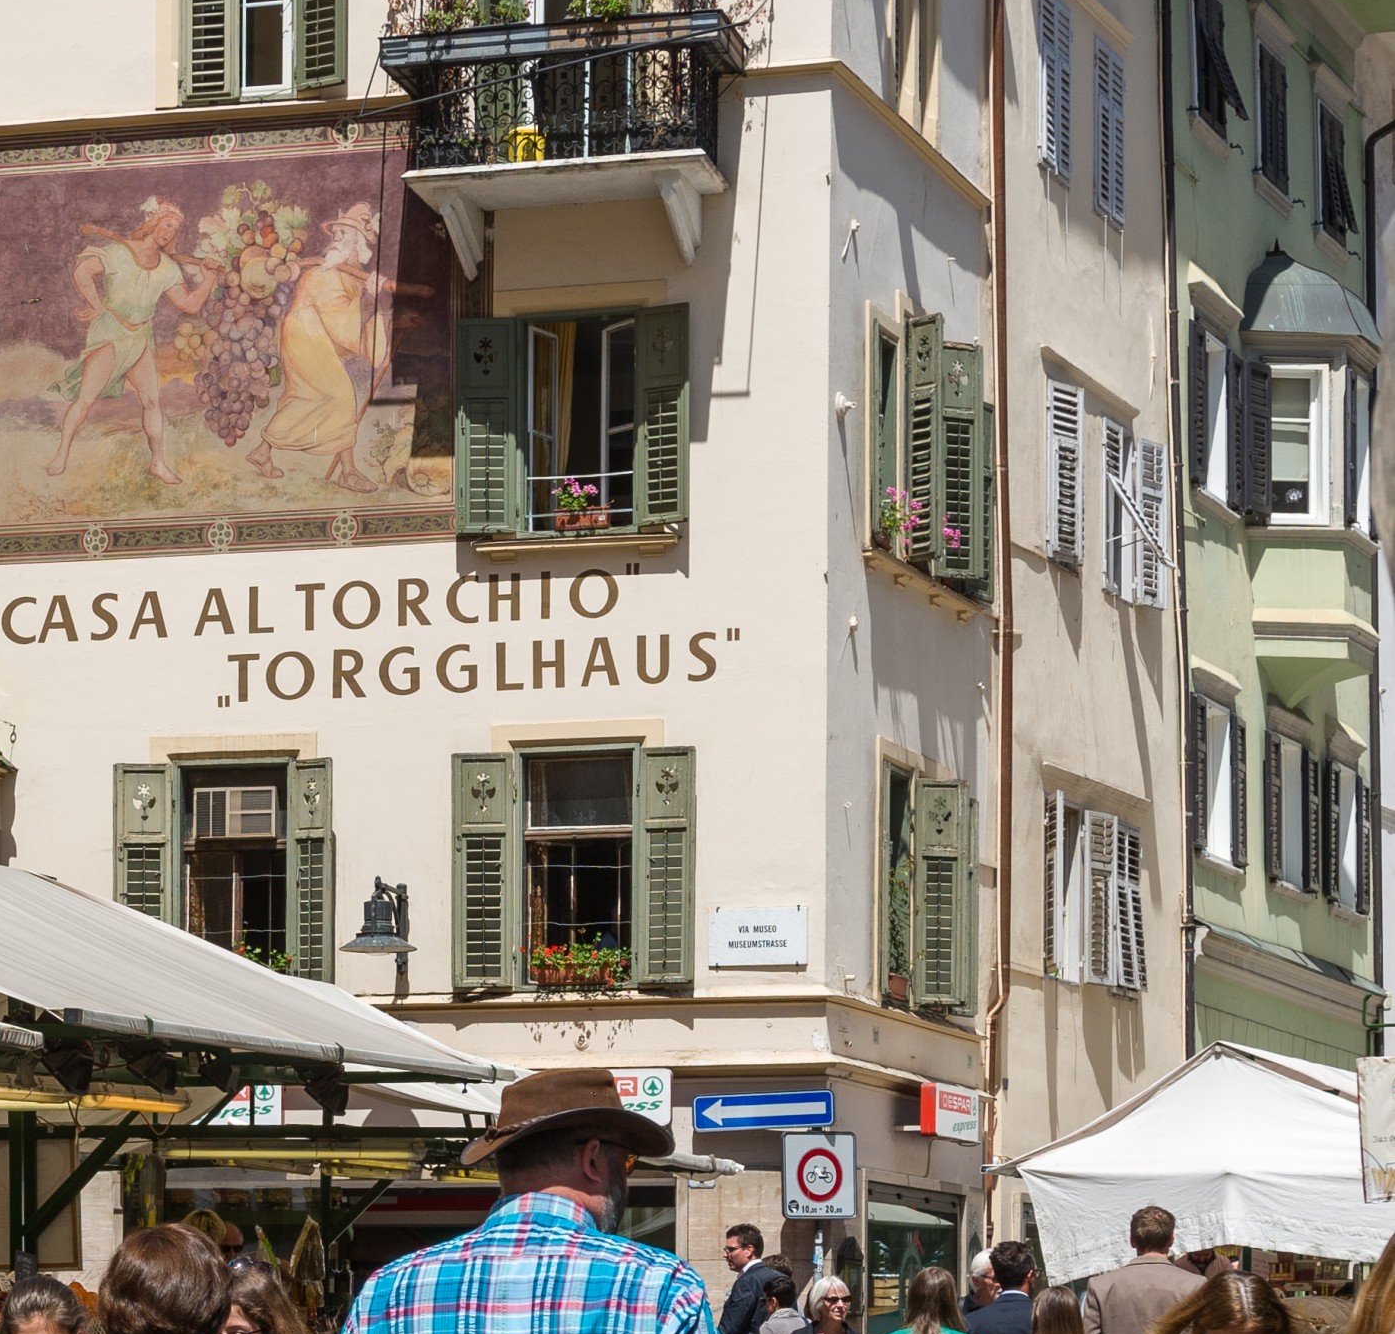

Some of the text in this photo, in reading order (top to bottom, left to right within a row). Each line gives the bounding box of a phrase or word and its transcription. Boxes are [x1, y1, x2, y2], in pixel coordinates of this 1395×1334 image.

[193, 586, 275, 637] AL
[738, 924, 777, 934] VIA MUSEO
[727, 939, 788, 949] MUSEUMSTRASSE
[942, 1093, 971, 1111] DESPAR
[219, 1104, 274, 1119] ress
[952, 1120, 977, 1134] express
